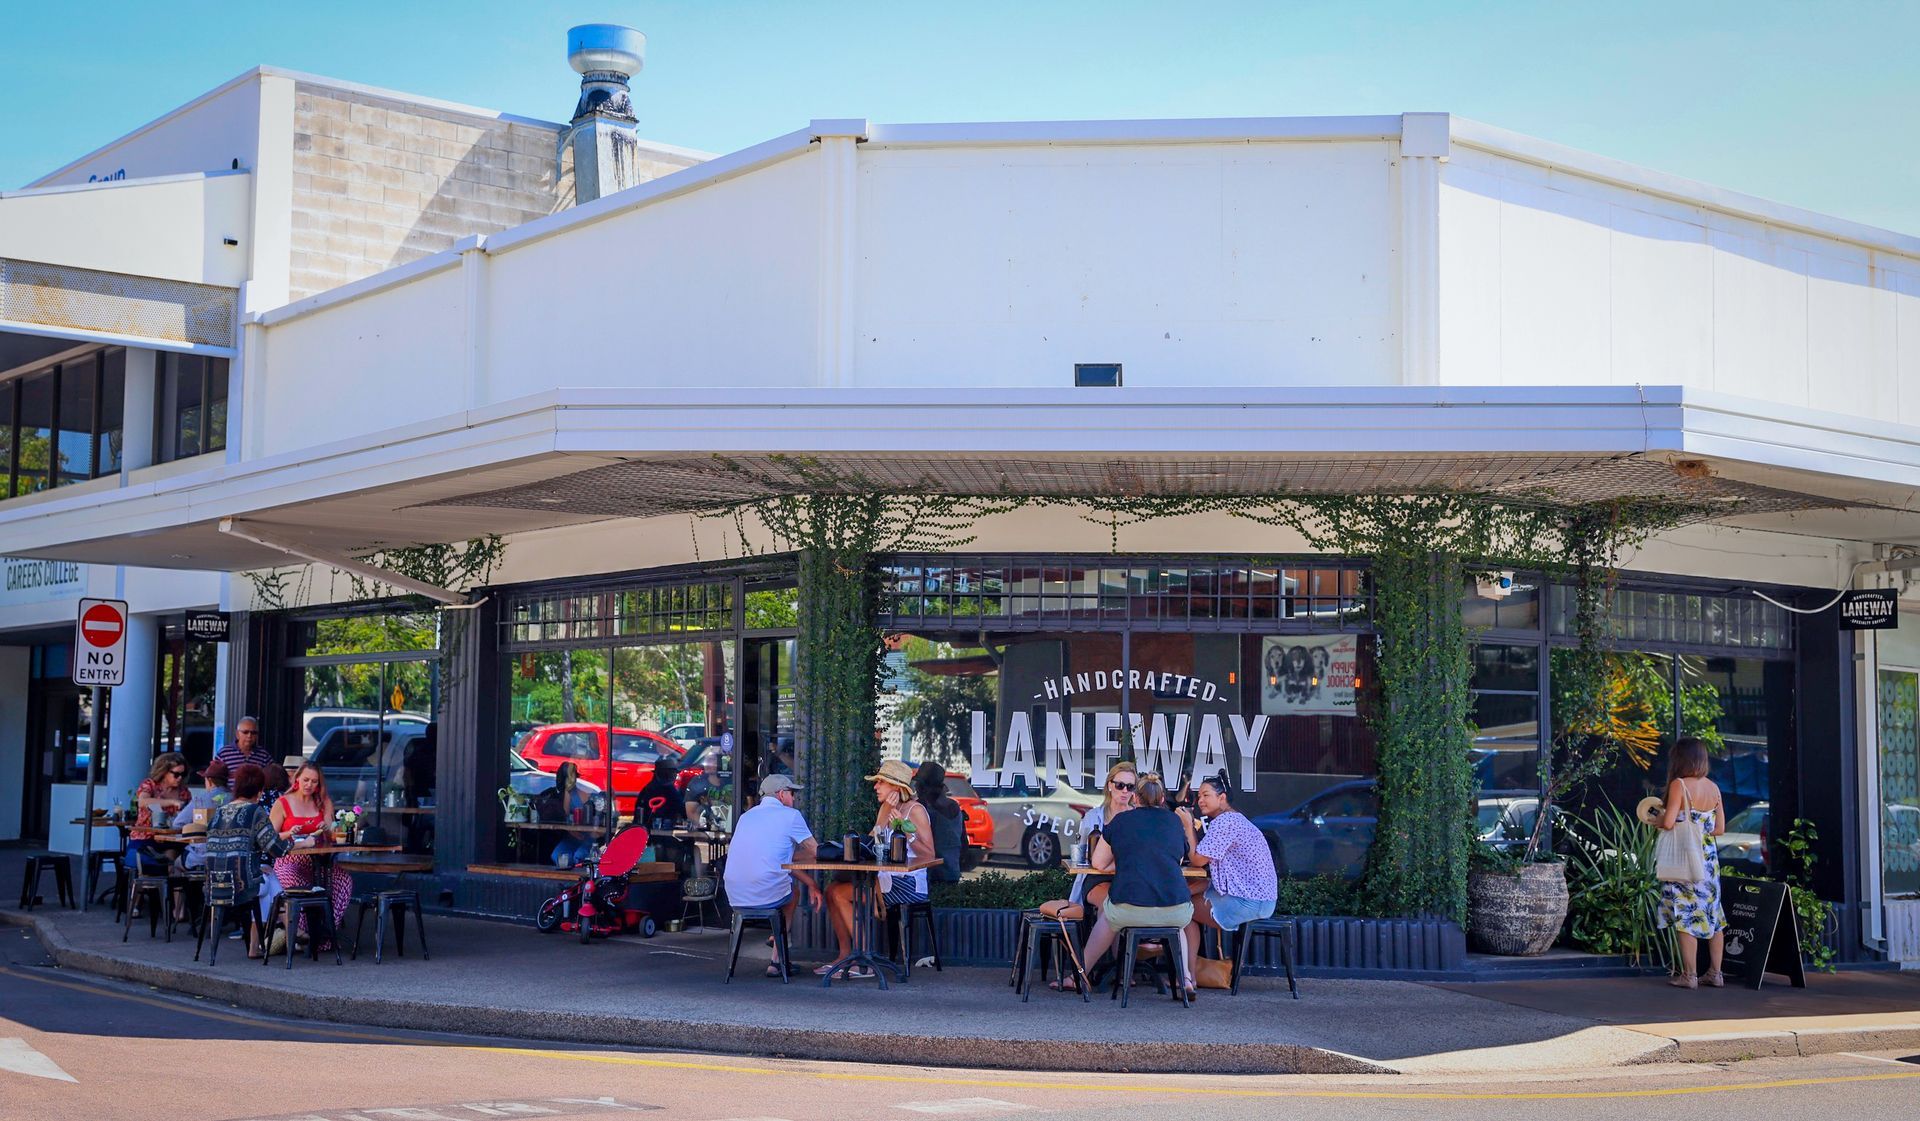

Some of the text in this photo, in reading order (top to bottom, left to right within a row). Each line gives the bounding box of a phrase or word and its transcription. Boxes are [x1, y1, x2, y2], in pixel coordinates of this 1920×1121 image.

[6, 560, 79, 591] CAREERS COLLEGE
[1842, 600, 1894, 617] LANEWAY
[187, 619, 228, 632] LANEWAY
[87, 651, 114, 666] NO
[80, 668, 119, 680] ENTRY
[971, 710, 1270, 793] LANEWAY
[1732, 909, 1756, 919] SERVING
[1733, 903, 1759, 912] PROUDLY
